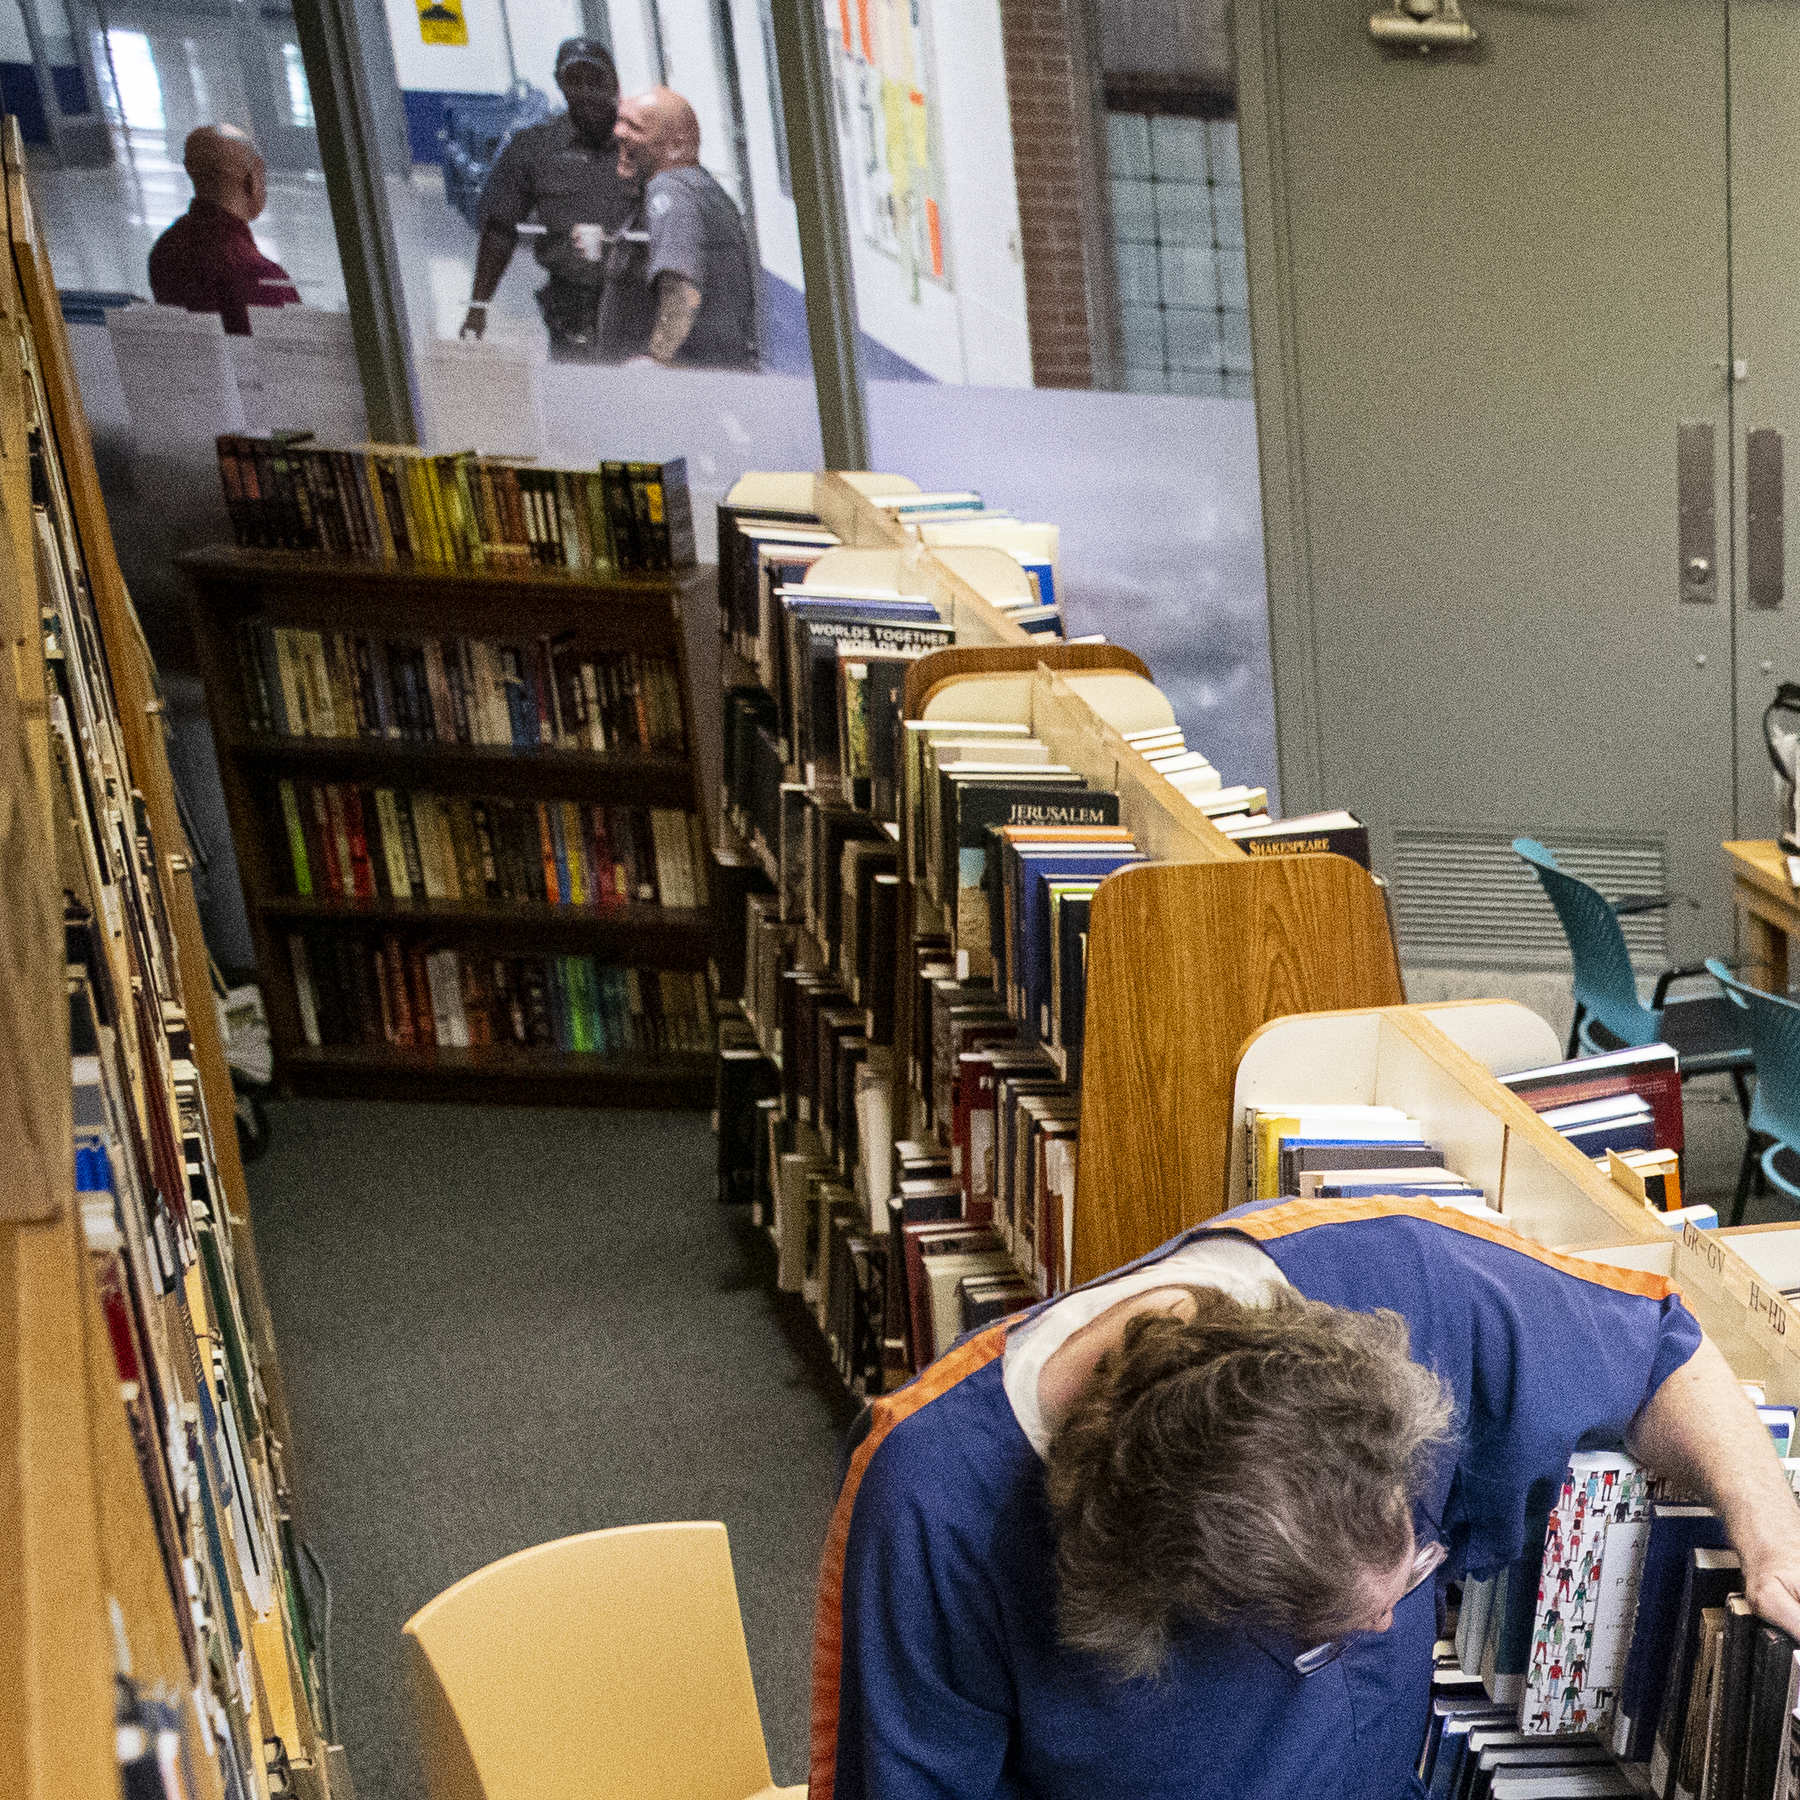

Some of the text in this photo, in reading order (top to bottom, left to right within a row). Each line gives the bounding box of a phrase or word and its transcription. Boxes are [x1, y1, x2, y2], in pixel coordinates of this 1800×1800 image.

[810, 622, 951, 648] WORLDS TOGETHER
[1009, 802, 1105, 825] JERUSALEM
